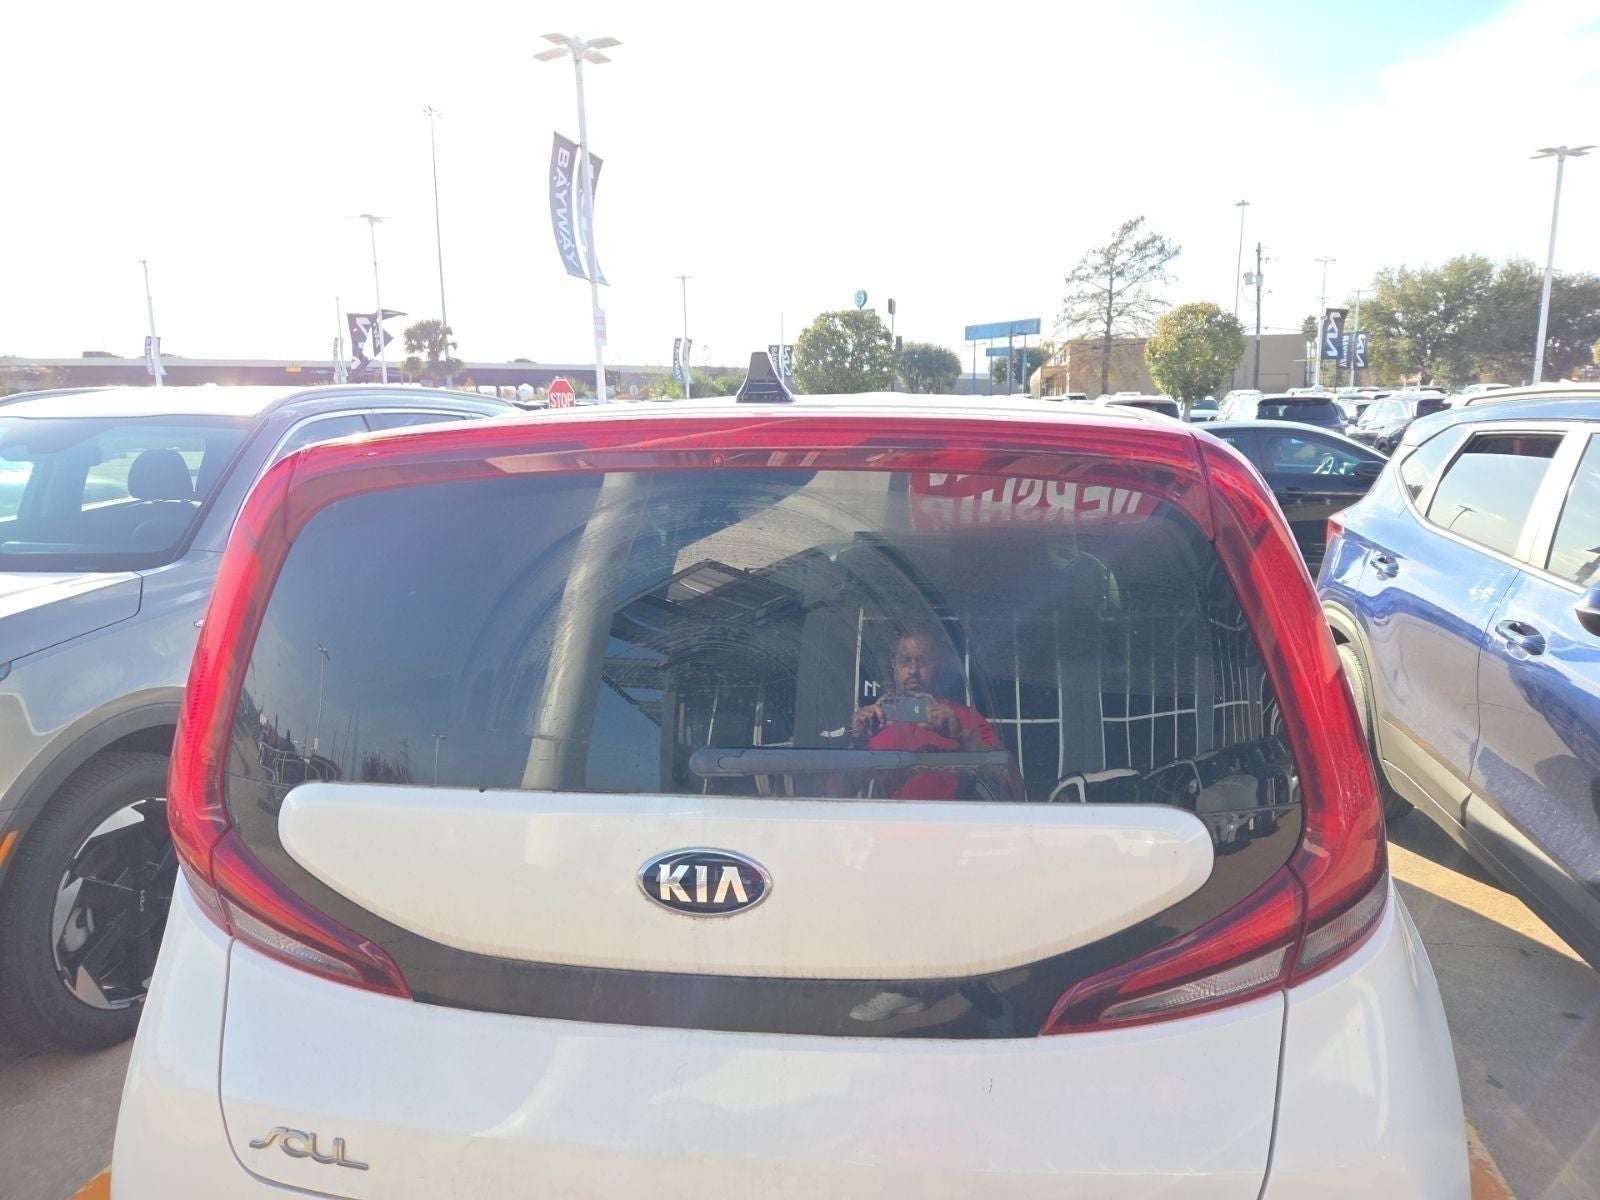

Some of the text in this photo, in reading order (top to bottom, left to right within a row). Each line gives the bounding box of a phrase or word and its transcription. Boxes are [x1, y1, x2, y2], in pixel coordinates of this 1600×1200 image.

[556, 147, 579, 269] BAYWAY
[550, 392, 574, 408] STOP
[659, 864, 749, 903] KIA
[249, 1126, 369, 1171] SOUL
